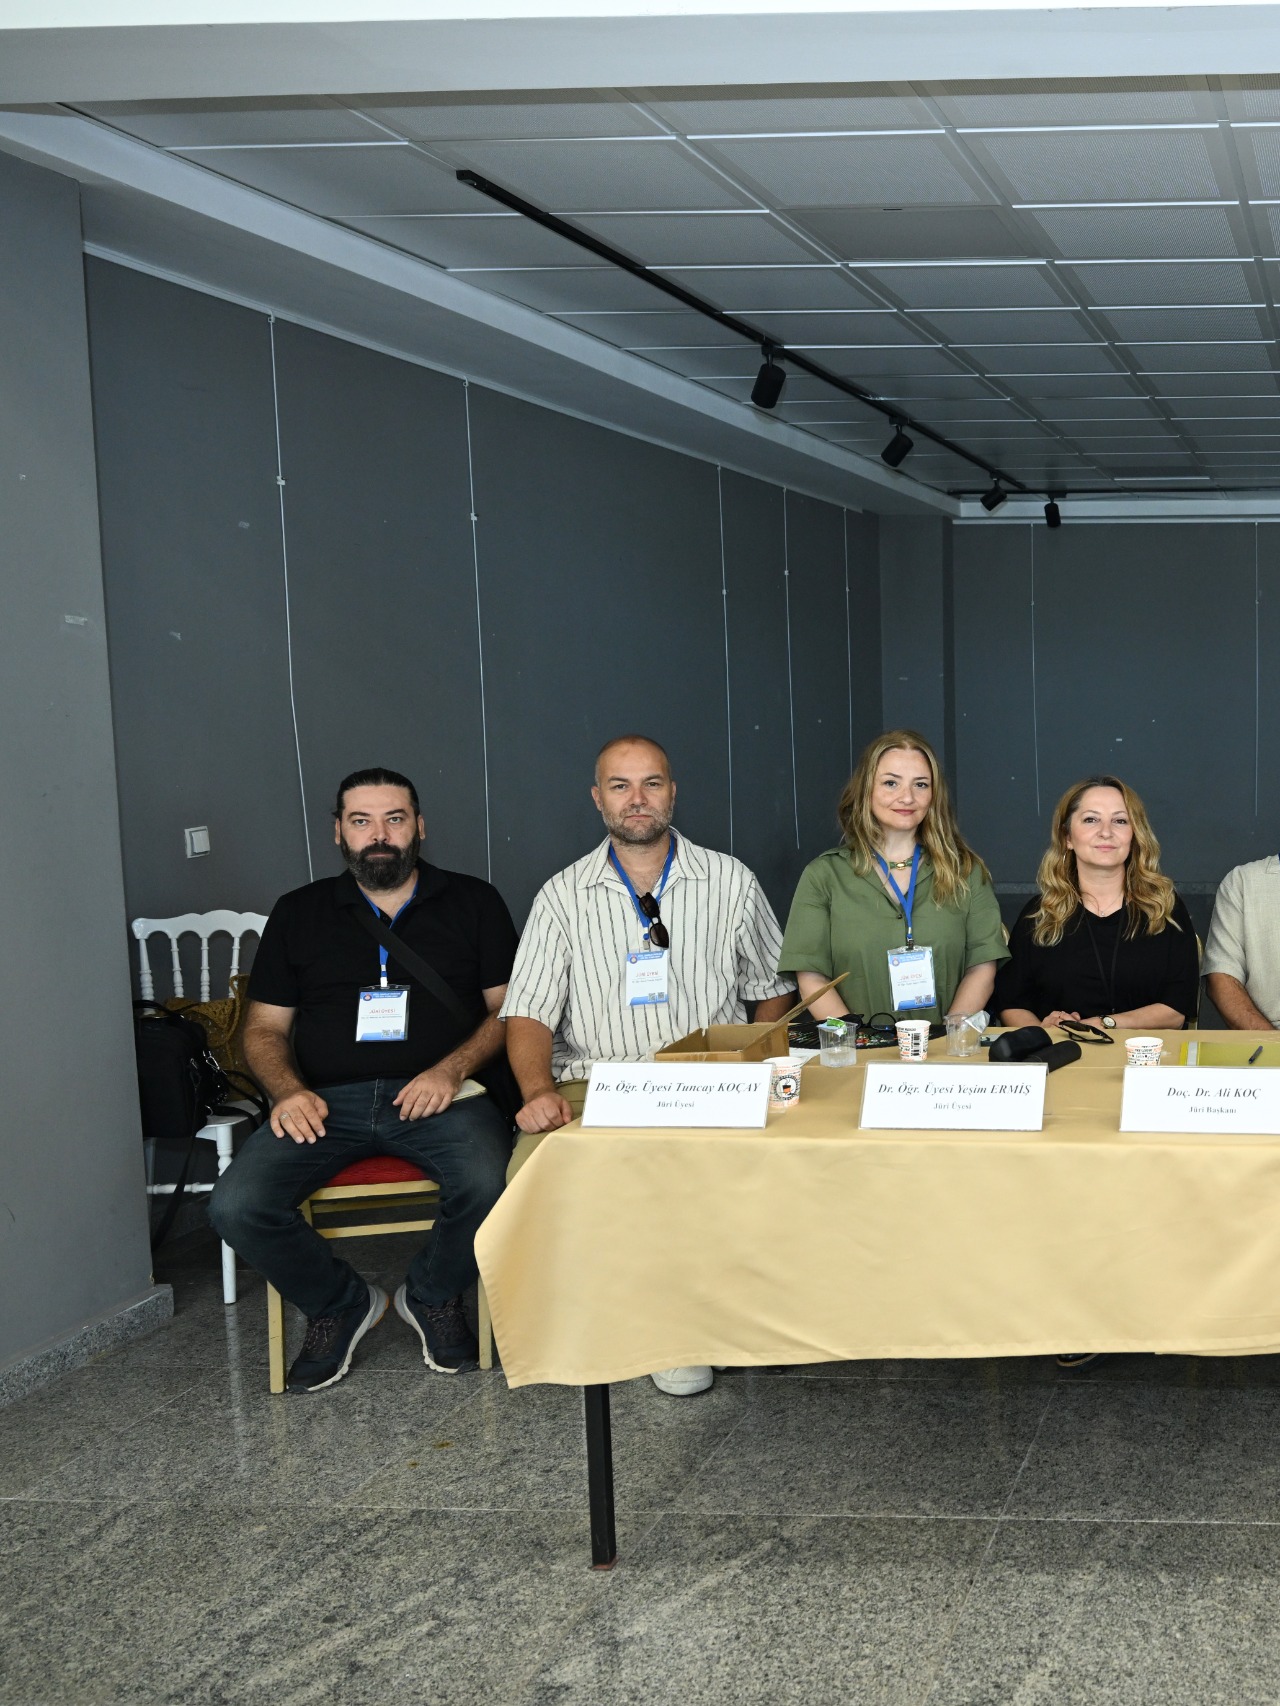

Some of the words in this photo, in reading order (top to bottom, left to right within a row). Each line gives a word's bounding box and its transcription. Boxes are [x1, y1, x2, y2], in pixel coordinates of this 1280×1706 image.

[595, 1082, 611, 1092] Dr.
[615, 1080, 638, 1094] Öğr.
[642, 1080, 672, 1094] Üyesi
[675, 1082, 715, 1094] Tuncay
[717, 1082, 761, 1094] KOÇAY
[878, 1083, 894, 1093] Dr.
[898, 1081, 920, 1095] Öğr.
[924, 1081, 954, 1096] Üyesi
[957, 1084, 987, 1095] Yeşim
[990, 1082, 1032, 1096] ERMİŞ
[1167, 1087, 1191, 1099] Doç.
[1195, 1087, 1211, 1097] Dr.
[1214, 1088, 1231, 1098] Ali
[1234, 1088, 1262, 1100] KOÇ
[674, 1100, 695, 1109] Üyesi
[933, 1102, 949, 1110] Jüri
[951, 1101, 972, 1111] Üyesi
[1206, 1106, 1237, 1115] Başkanı
